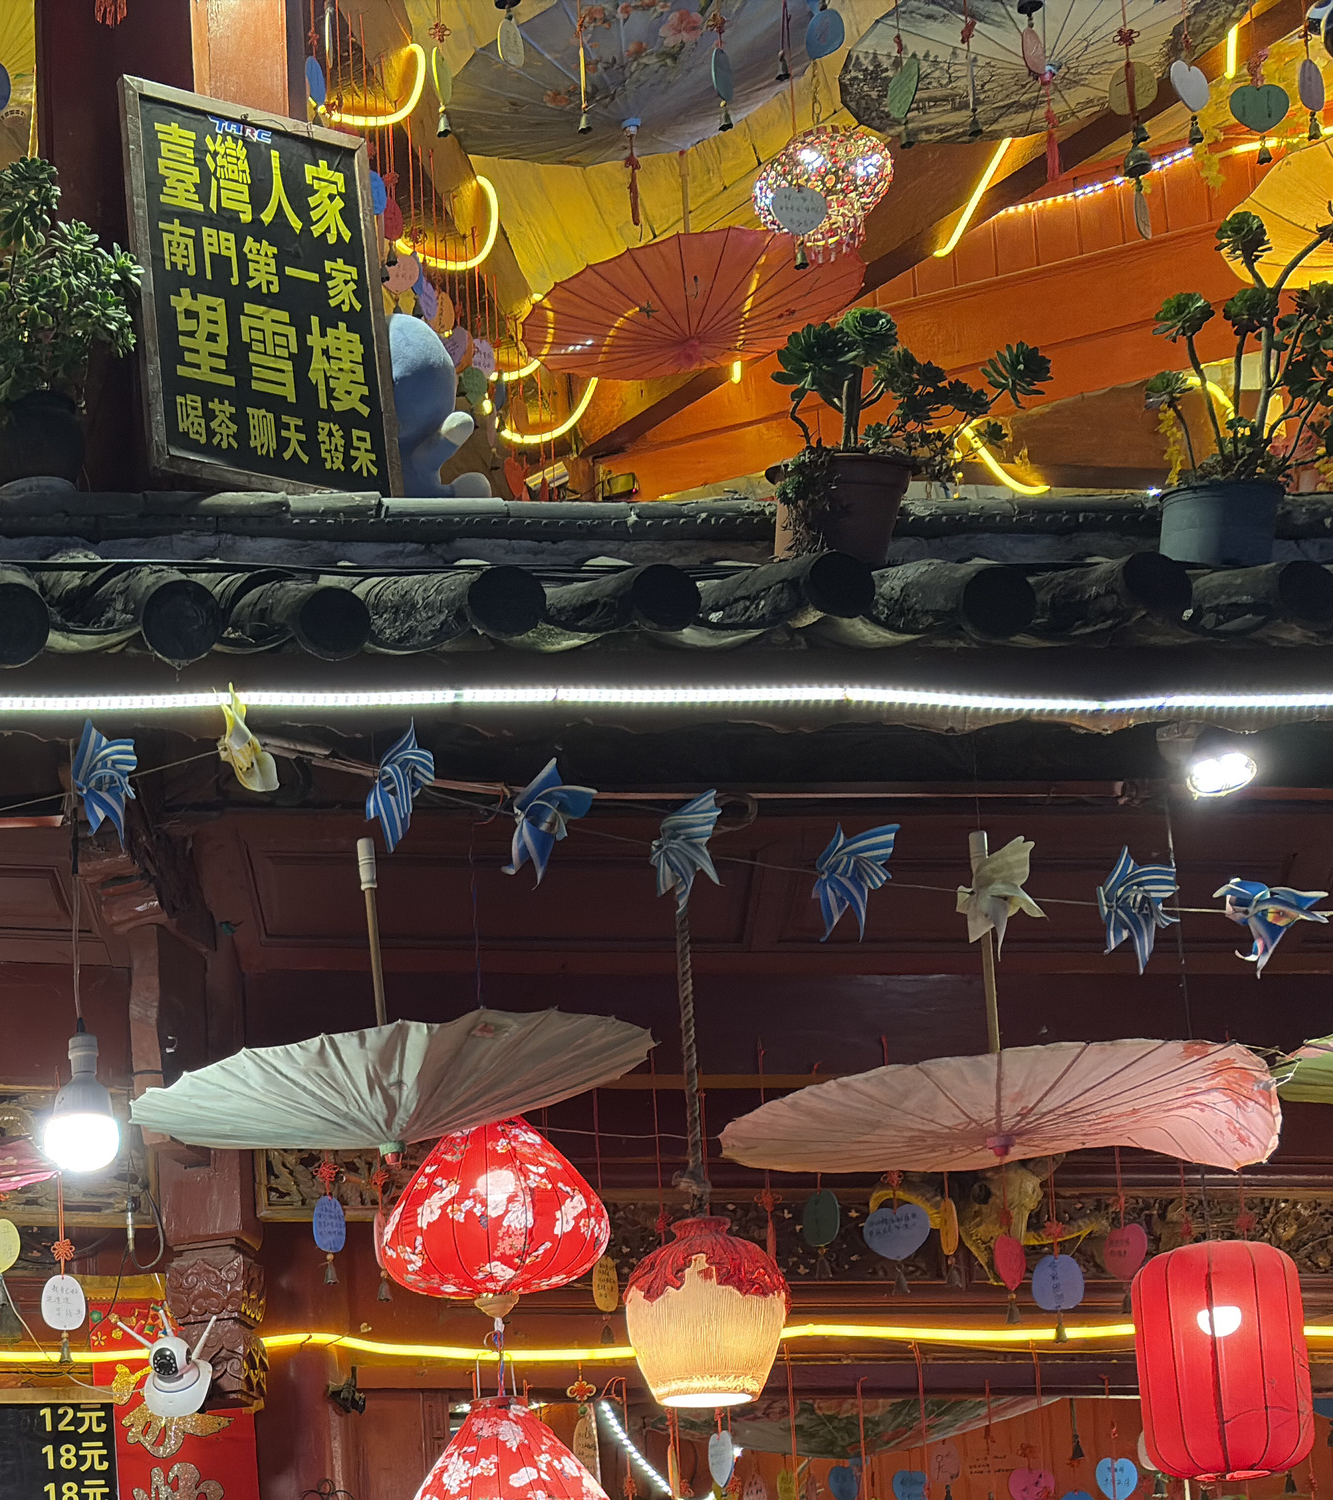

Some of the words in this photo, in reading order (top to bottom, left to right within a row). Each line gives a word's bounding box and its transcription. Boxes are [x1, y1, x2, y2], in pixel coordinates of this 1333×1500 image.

[206, 114, 272, 144] TARC
[154, 122, 352, 244] 臺灣人家
[158, 218, 362, 313] 南門第一家
[170, 287, 371, 417] 望雪樓
[176, 394, 238, 449] 喝茶
[248, 407, 309, 463] 聊天
[317, 421, 378, 478] 發呆
[39, 1403, 107, 1433] 12元
[41, 1442, 109, 1471] 18元
